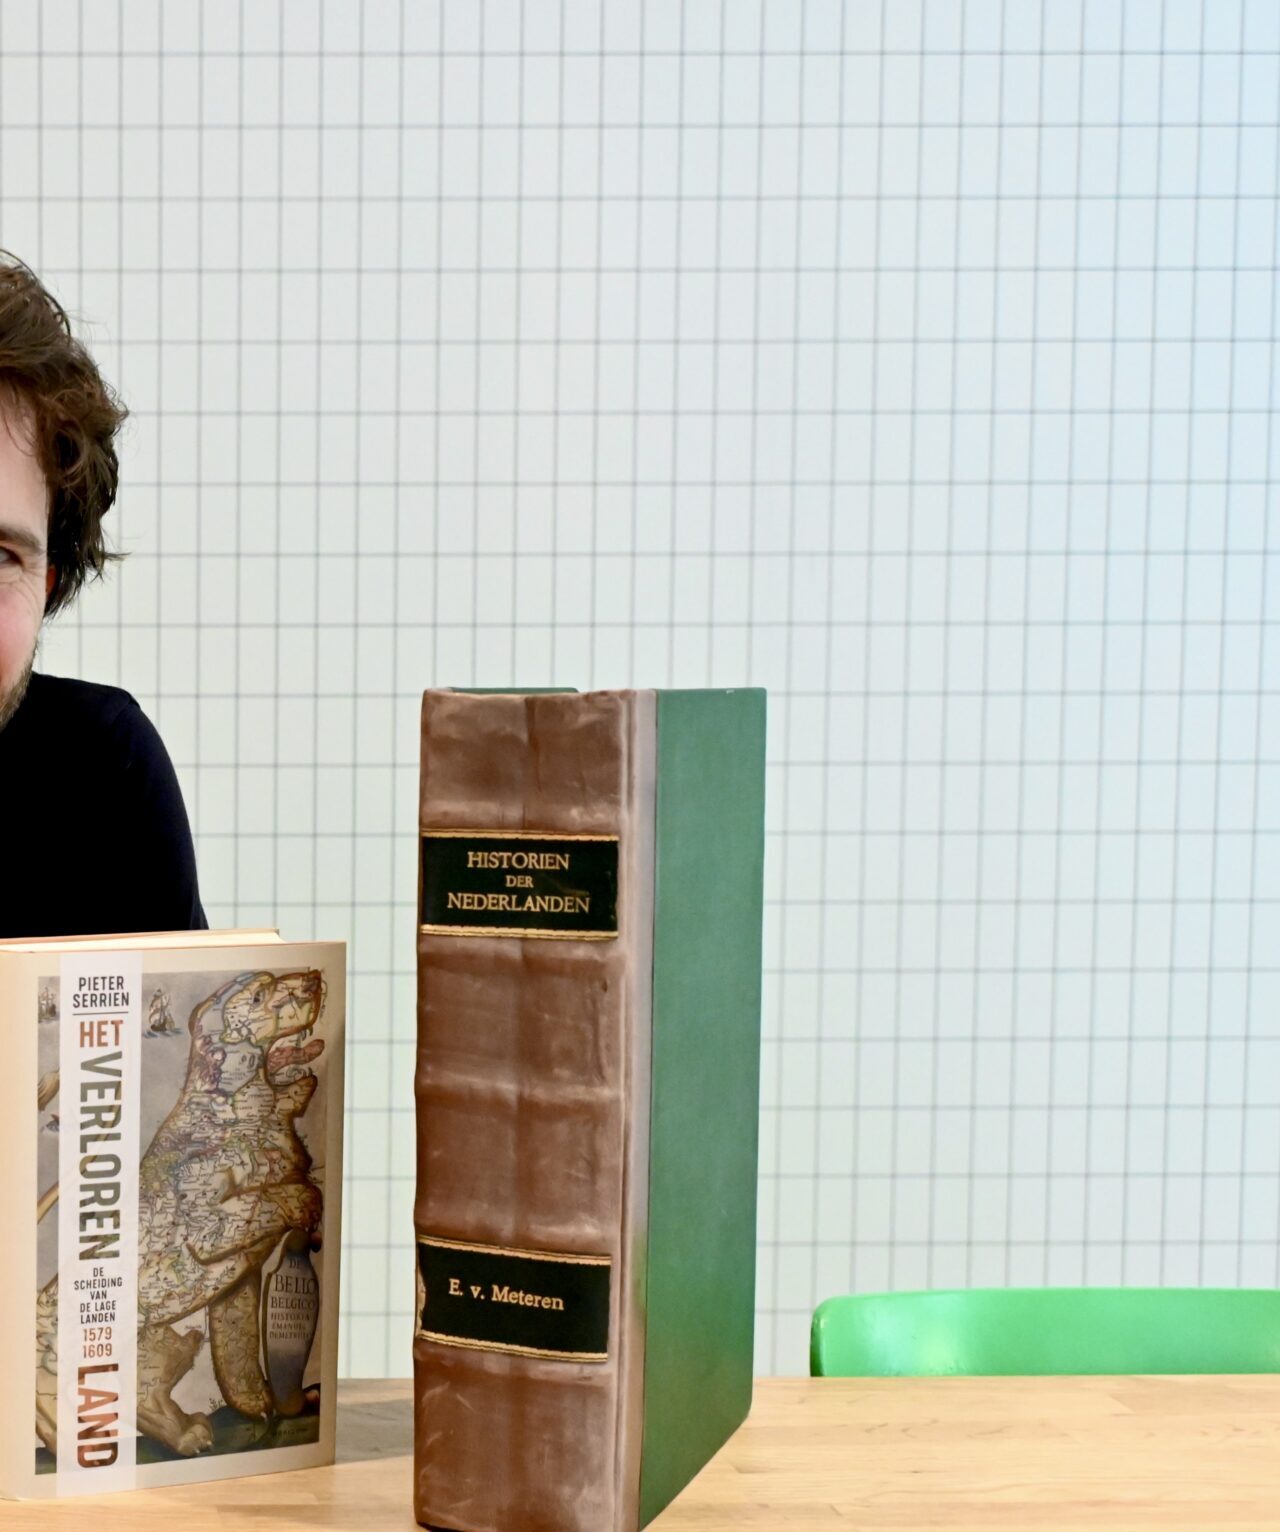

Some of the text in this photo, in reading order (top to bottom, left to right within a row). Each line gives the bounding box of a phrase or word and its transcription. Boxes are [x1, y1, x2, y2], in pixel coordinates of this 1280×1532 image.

[467, 851, 570, 870] HISTORIEN
[505, 874, 534, 888] DER
[447, 892, 590, 913] NEDERLANDEN
[78, 975, 125, 992] PIETER
[72, 991, 130, 1009] SERRIEN
[79, 1018, 124, 1048] HET
[78, 1050, 122, 1261] VERLOREN
[93, 1267, 104, 1277] DE
[74, 1277, 123, 1290] SCHEIDING
[90, 1290, 107, 1300] VAN
[448, 1278, 564, 1311] E. v. Meteren
[80, 1300, 117, 1313] DE LAGE
[80, 1312, 116, 1324] LANDEN
[83, 1326, 112, 1342] 1579
[83, 1343, 112, 1358] 1609
[77, 1362, 120, 1469] LAND
